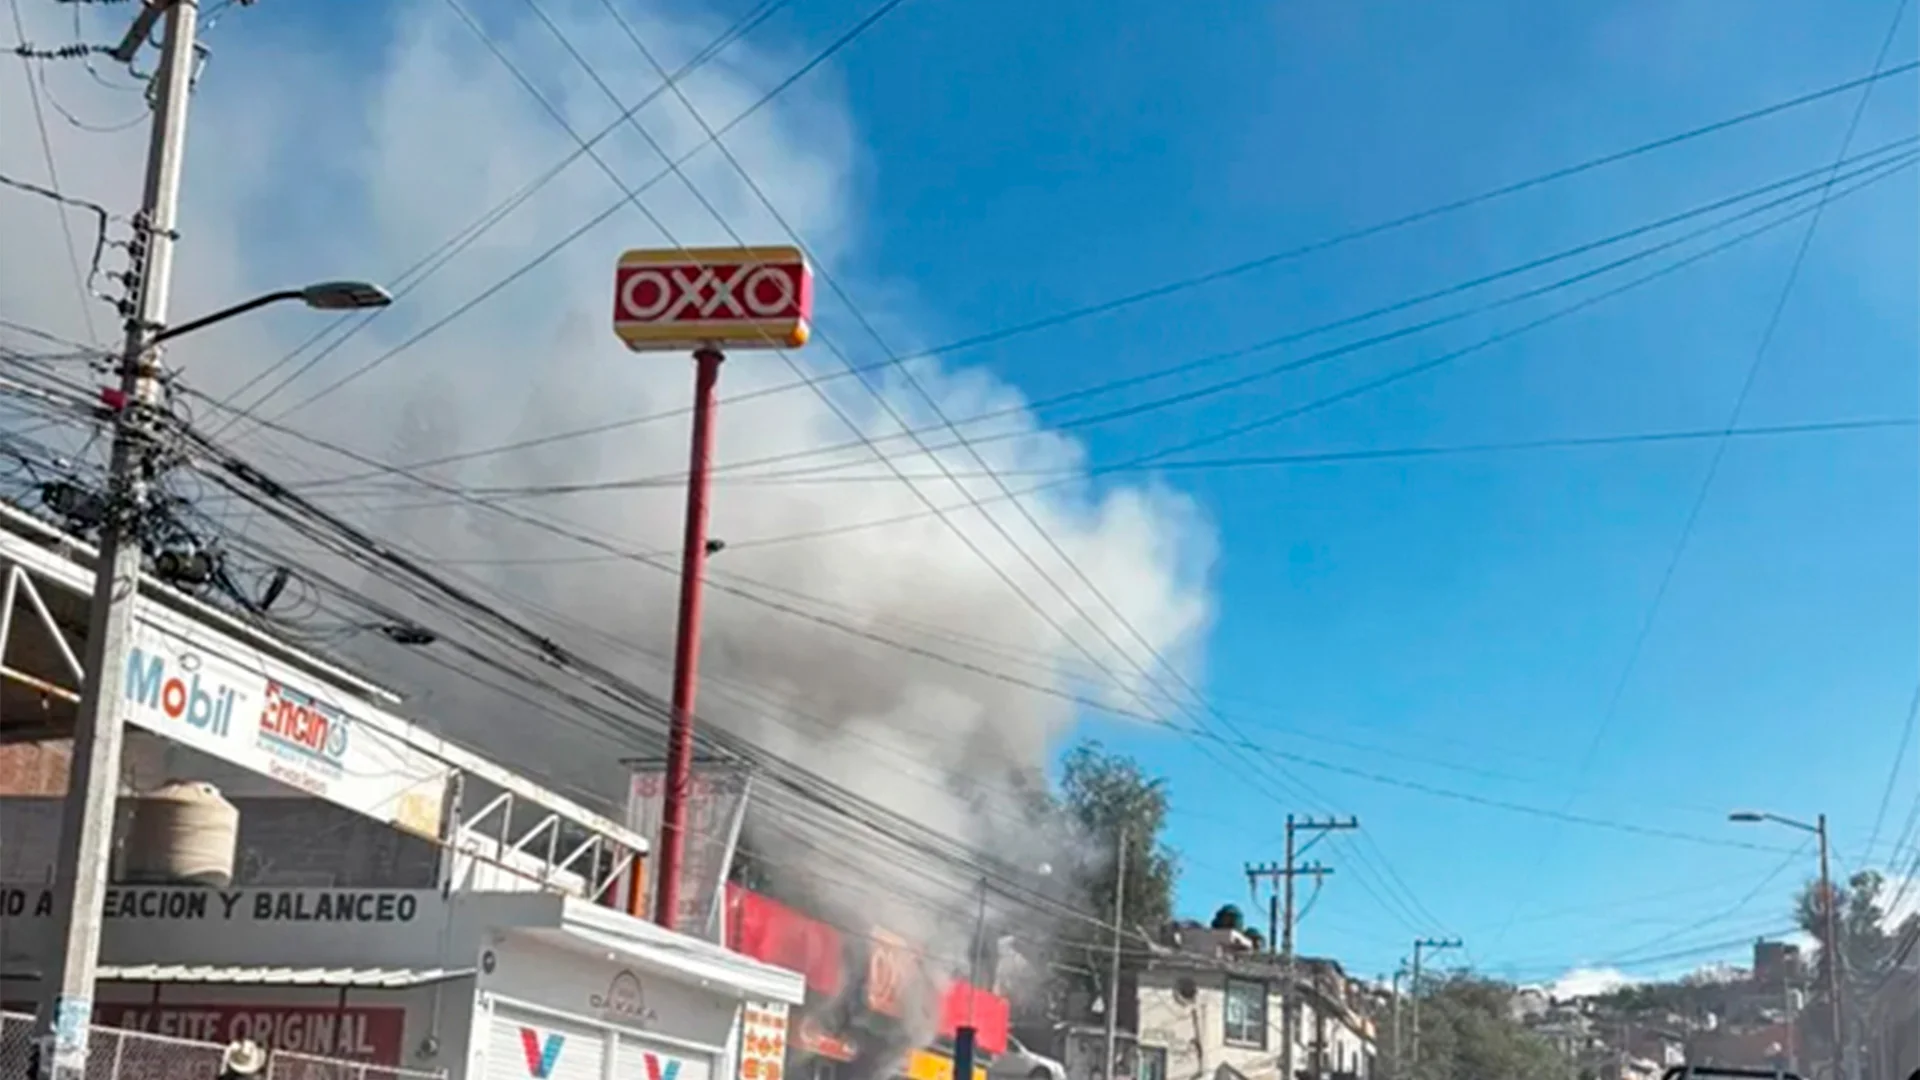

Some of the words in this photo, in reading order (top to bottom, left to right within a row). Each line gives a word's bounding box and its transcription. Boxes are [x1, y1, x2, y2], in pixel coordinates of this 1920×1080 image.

[621, 265, 795, 320] OXXO
[126, 647, 234, 737] Mobil
[218, 891, 242, 919] Y
[253, 891, 417, 922] BALANCEO
[228, 1012, 375, 1053] ORIGINAL
